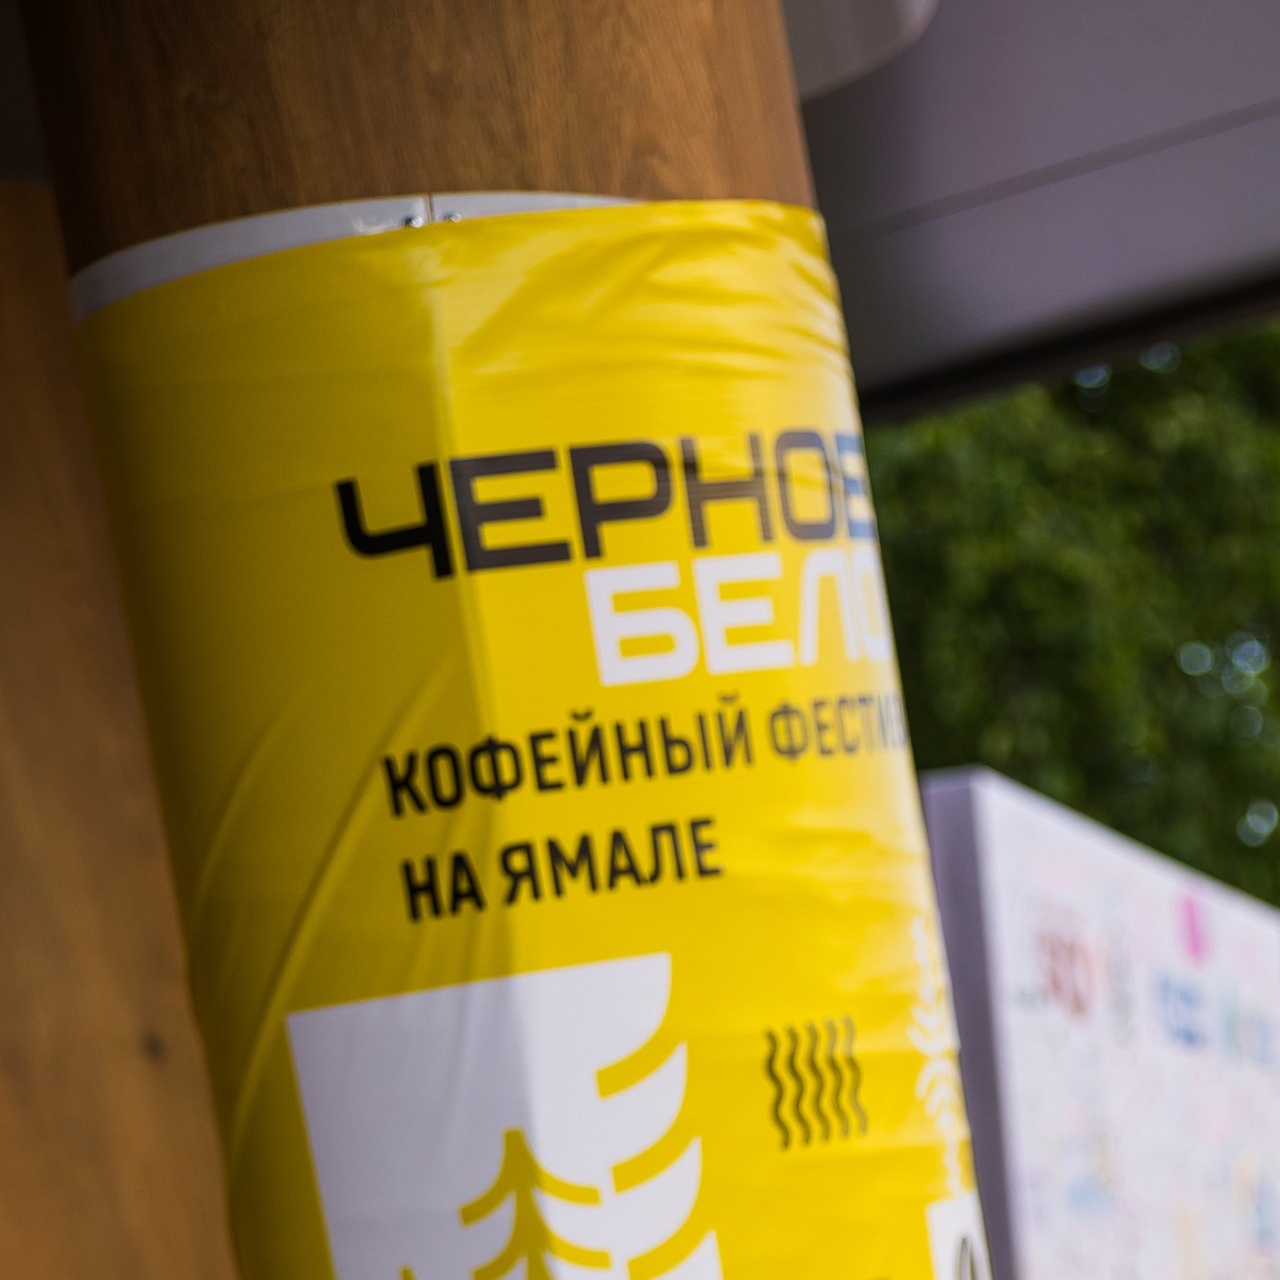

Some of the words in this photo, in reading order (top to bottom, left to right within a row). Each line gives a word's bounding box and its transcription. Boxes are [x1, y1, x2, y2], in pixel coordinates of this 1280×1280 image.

[381, 691, 754, 818] КОФЕЙНЫЙ
[400, 849, 487, 923] НА
[500, 817, 723, 907] ЯМАЛЕ
